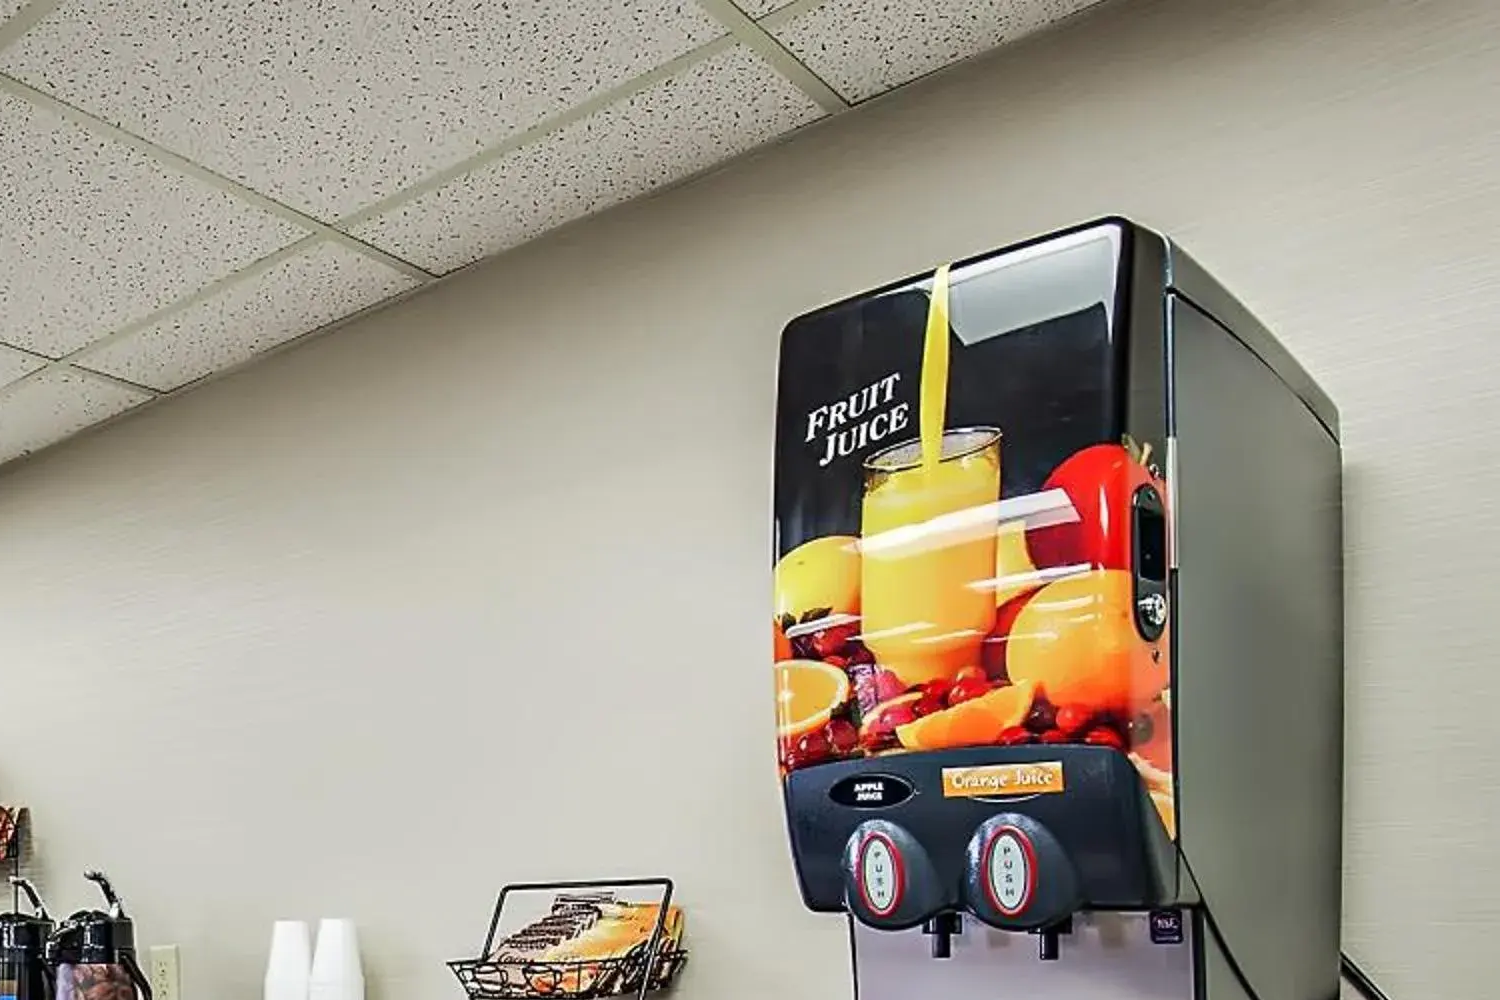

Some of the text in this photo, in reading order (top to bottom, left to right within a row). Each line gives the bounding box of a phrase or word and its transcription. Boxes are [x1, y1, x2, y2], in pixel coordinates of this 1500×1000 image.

[804, 372, 901, 442] FRUIT
[819, 402, 909, 467] JUICE
[854, 782, 885, 792] APPLE
[856, 791, 883, 801] JUICE
[952, 767, 1053, 791] Orange Juice
[873, 851, 886, 898] PUSH
[1002, 847, 1016, 897] PUSH
